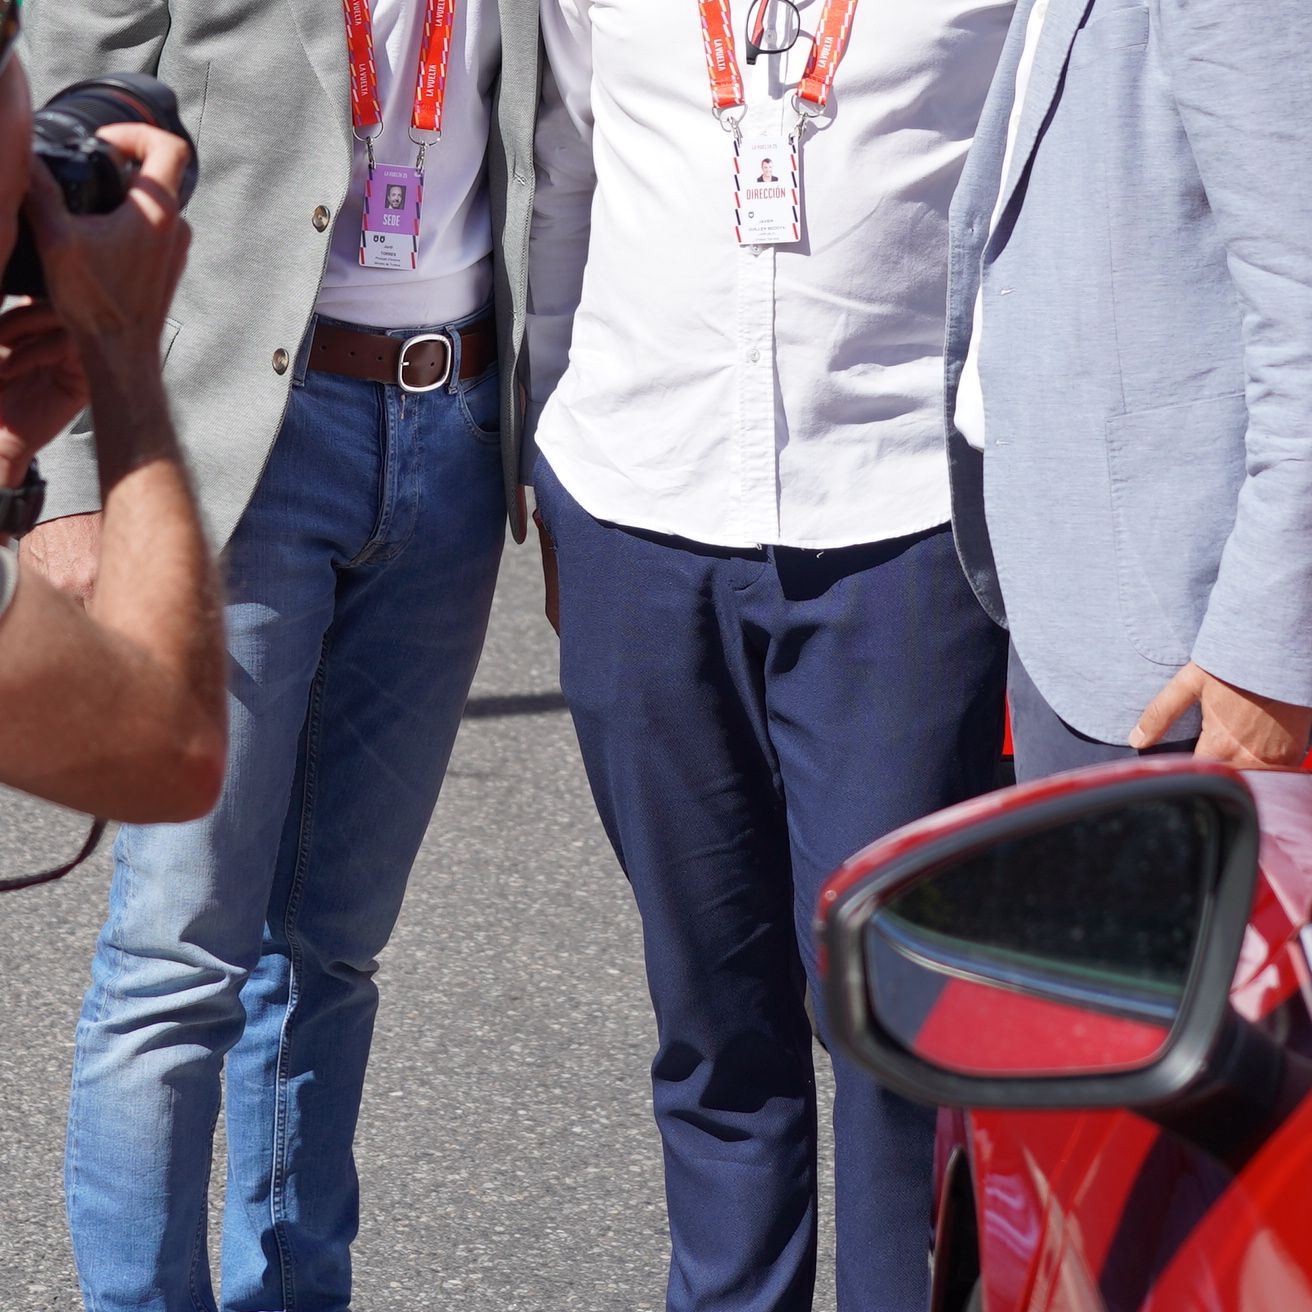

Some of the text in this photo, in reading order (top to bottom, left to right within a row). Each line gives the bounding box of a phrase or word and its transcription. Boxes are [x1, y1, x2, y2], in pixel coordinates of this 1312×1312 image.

[353, 0, 362, 26] VUELTA
[715, 46, 726, 71] VUELTA
[360, 71, 368, 96] VUELTA
[427, 65, 437, 89] VUELTA
[746, 186, 786, 200] DIRECCIÓN
[383, 214, 401, 226] SEDE
